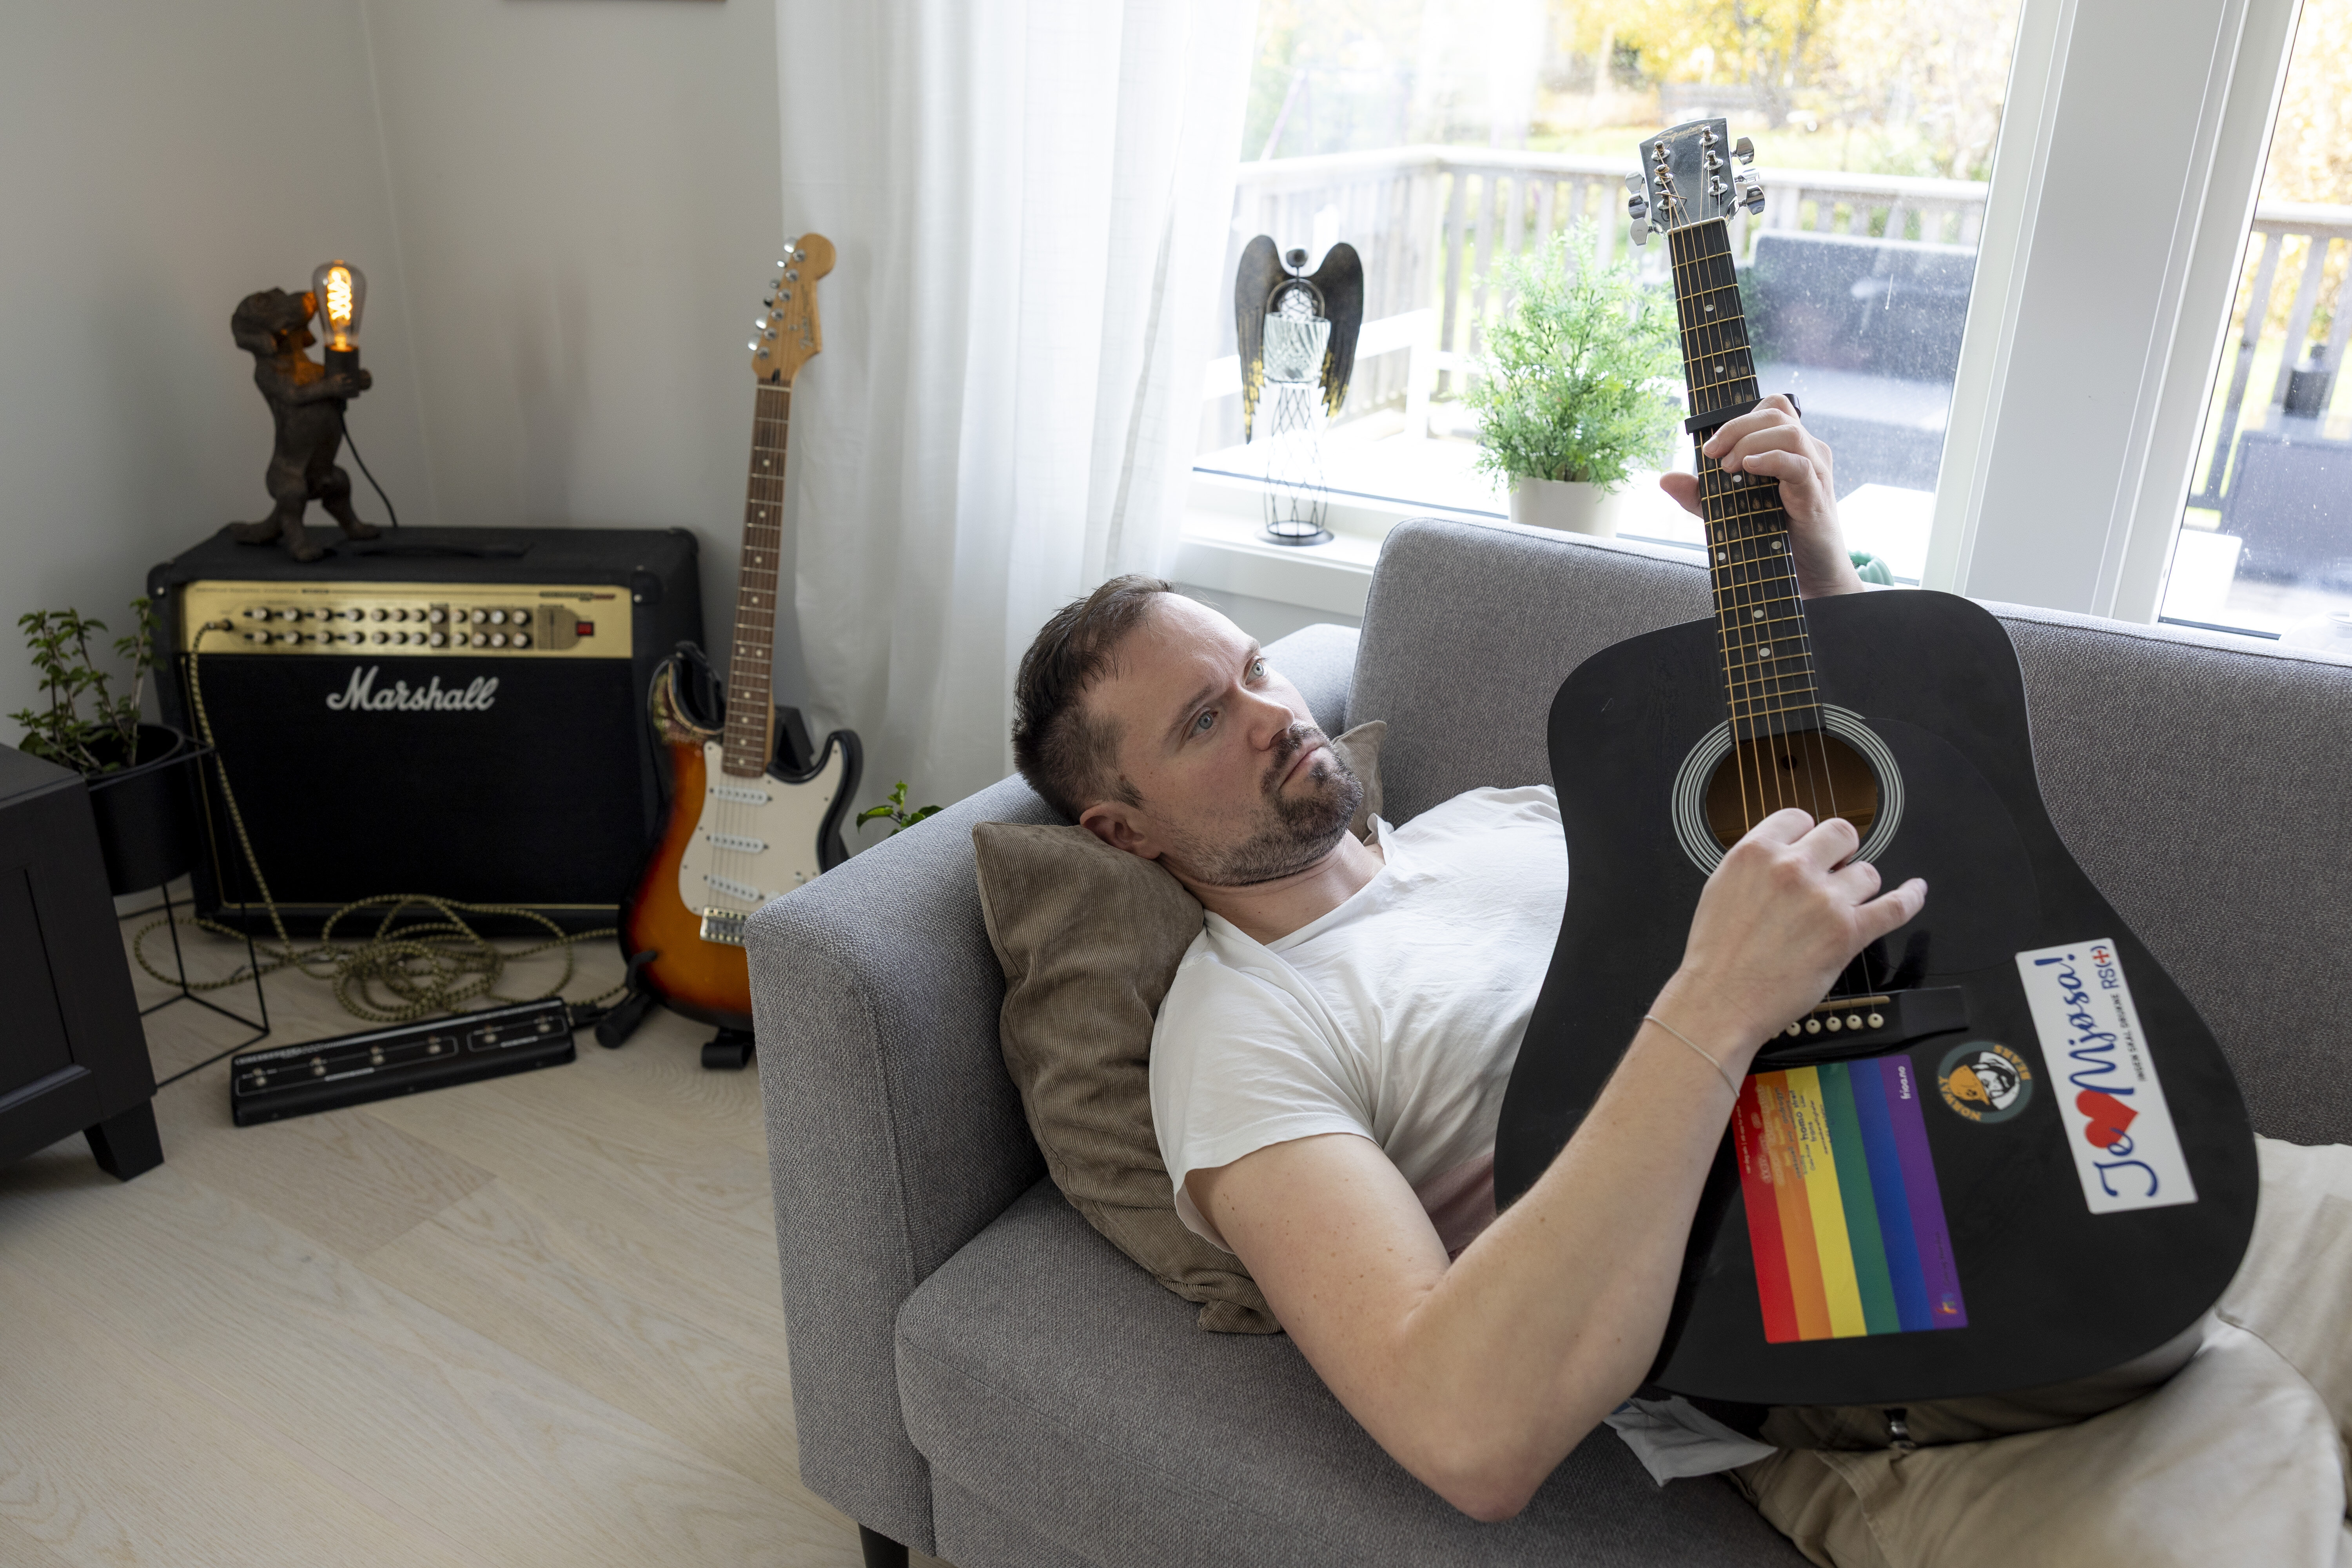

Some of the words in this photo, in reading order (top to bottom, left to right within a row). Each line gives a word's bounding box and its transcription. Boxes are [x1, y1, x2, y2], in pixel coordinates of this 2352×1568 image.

[326, 666, 499, 711] Marshall
[2033, 954, 2135, 1095] Mjøsa!
[1938, 1076, 1981, 1121] NORWAY
[1797, 1112, 1808, 1141] homo
[2093, 1127, 2159, 1197] Je
